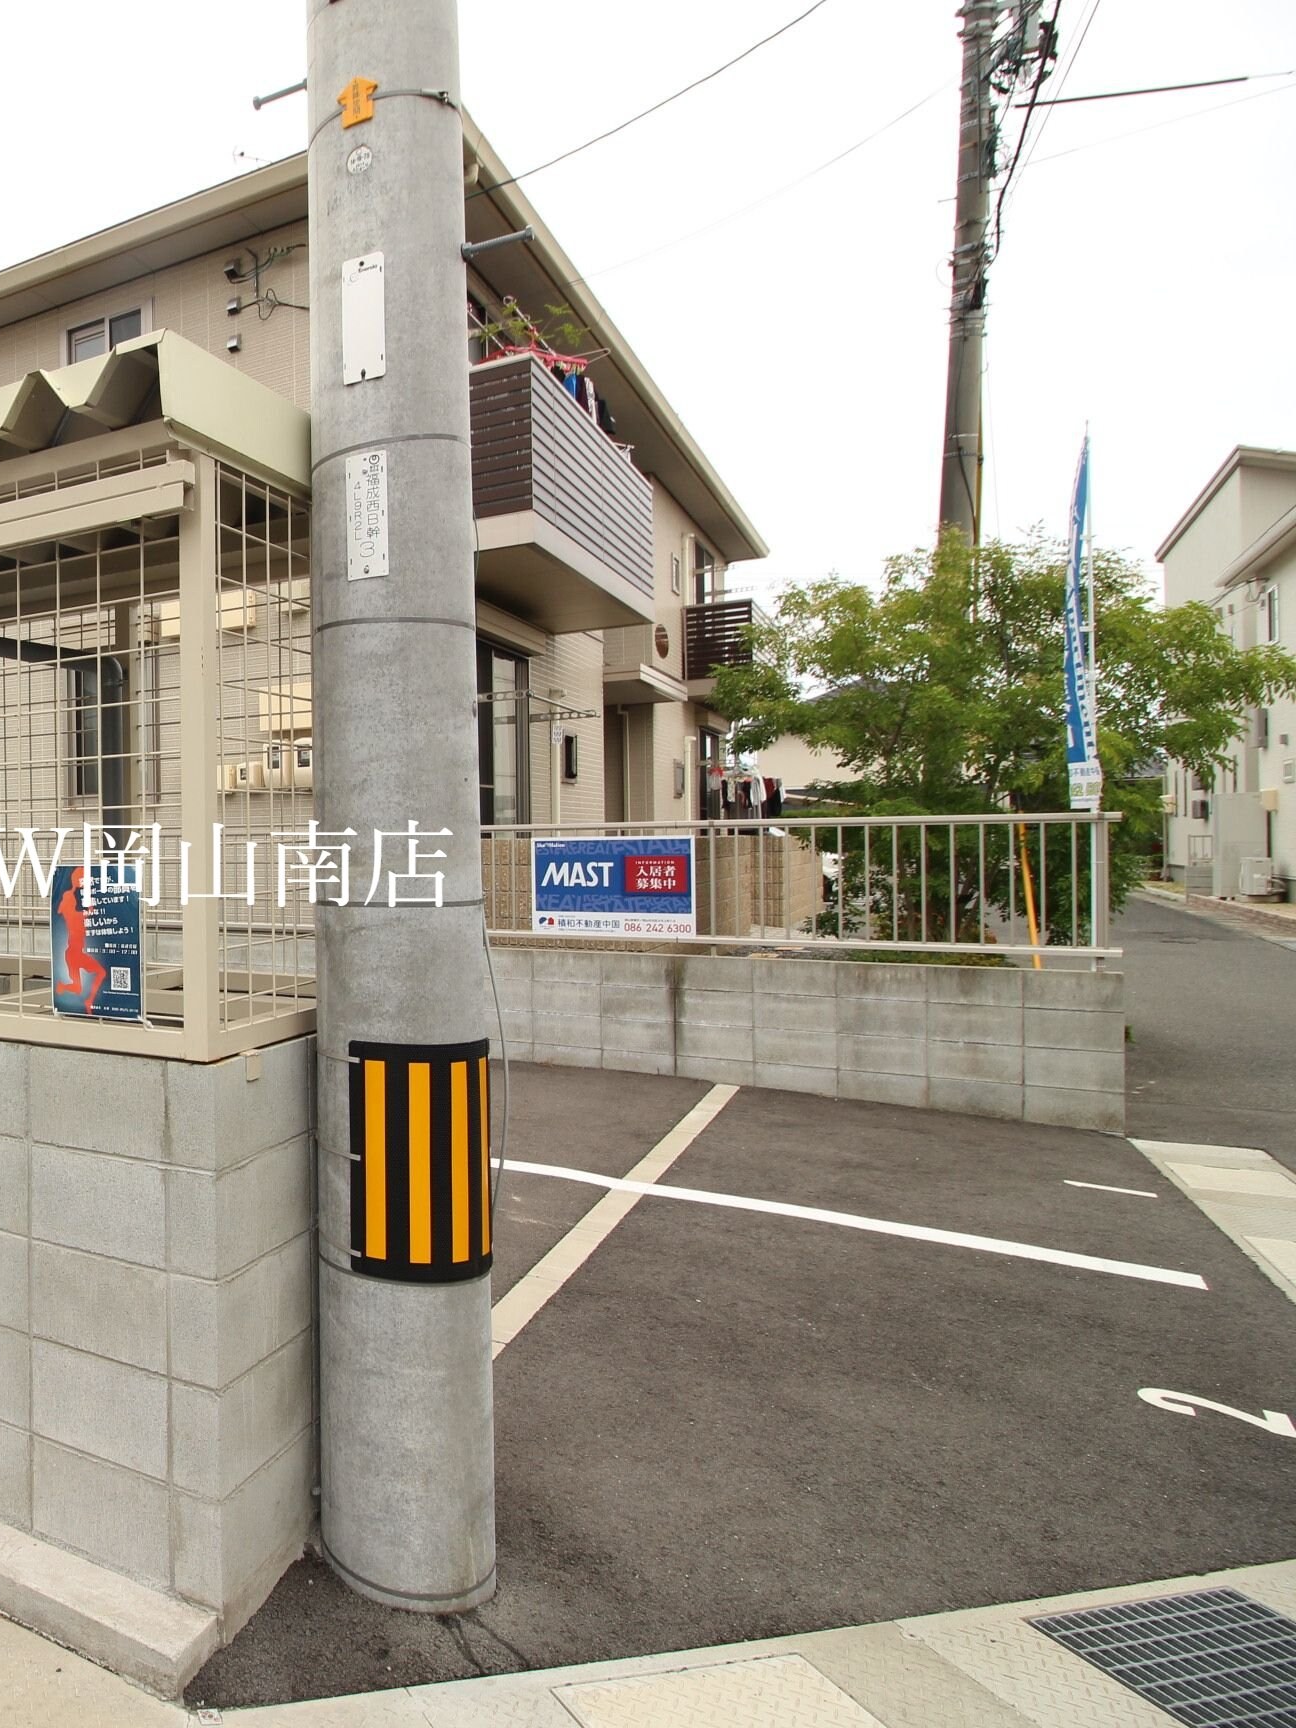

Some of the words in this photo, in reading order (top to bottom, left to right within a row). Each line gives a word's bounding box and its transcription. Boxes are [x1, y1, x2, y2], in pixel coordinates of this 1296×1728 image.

[360, 541, 375, 558] 3
[541, 862, 614, 888] MAST
[635, 865, 676, 877] 入居者
[635, 878, 676, 891] 募集中
[558, 918, 620, 929] 積和不動産中国
[624, 922, 642, 932] 086
[646, 923, 664, 933] 242
[667, 924, 691, 934] 6300
